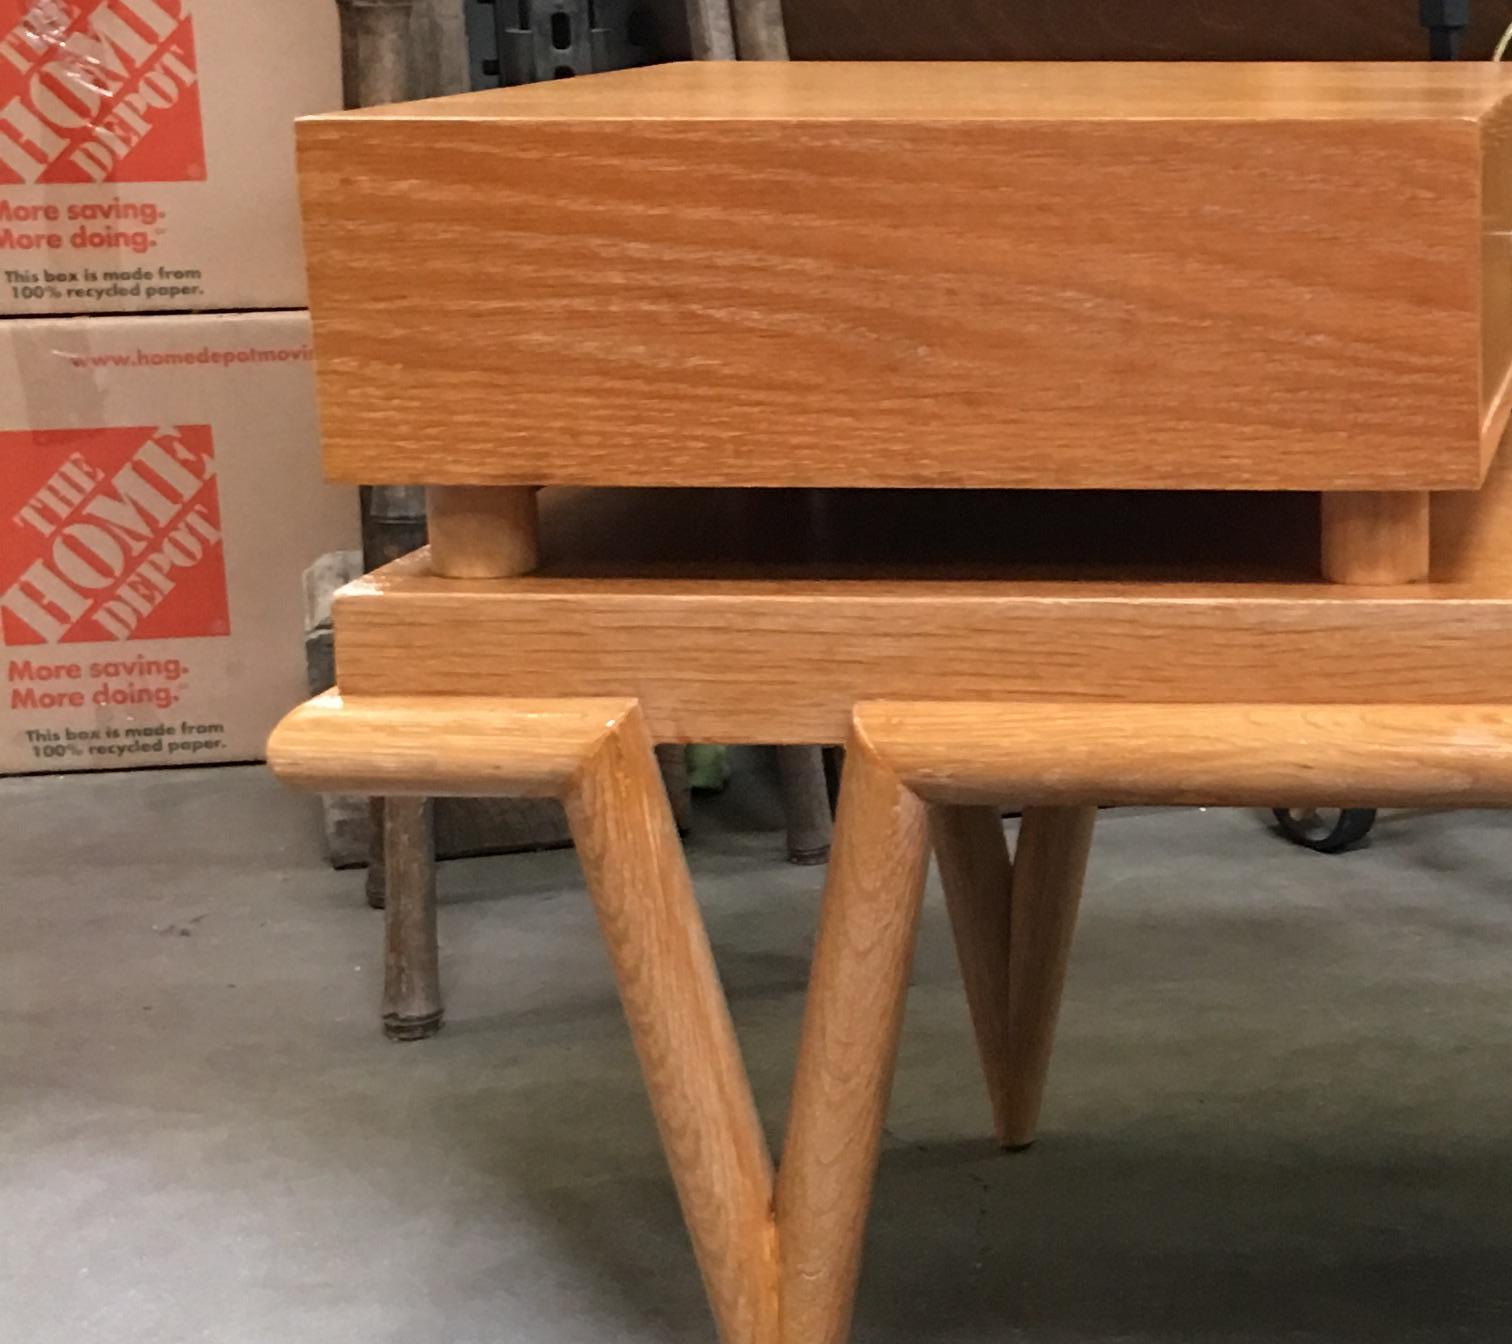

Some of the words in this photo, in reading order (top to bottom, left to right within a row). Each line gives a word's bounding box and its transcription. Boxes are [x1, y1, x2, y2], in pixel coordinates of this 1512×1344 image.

[70, 44, 198, 183] DEPOT
[67, 197, 166, 225] saving.
[70, 225, 157, 253] doing.
[5, 268, 39, 283] This
[43, 269, 79, 283] box
[84, 268, 98, 282] is
[103, 267, 153, 282] made
[158, 266, 202, 280] from
[12, 285, 62, 300] 100%
[67, 283, 140, 300] recycled
[145, 284, 205, 299] paper.
[12, 451, 106, 538] THE
[0, 425, 215, 644] HOME
[91, 503, 222, 641] DEPOT
[8, 660, 82, 682] More
[90, 654, 189, 681] saving.
[11, 687, 85, 709] More
[92, 682, 180, 709] doing.
[26, 729, 61, 743] This
[65, 727, 100, 741] box
[105, 725, 120, 739] is
[125, 723, 176, 738] made
[181, 721, 224, 735] from
[32, 744, 82, 758] 100%
[88, 740, 163, 757] recycled
[168, 739, 227, 754] paper.
